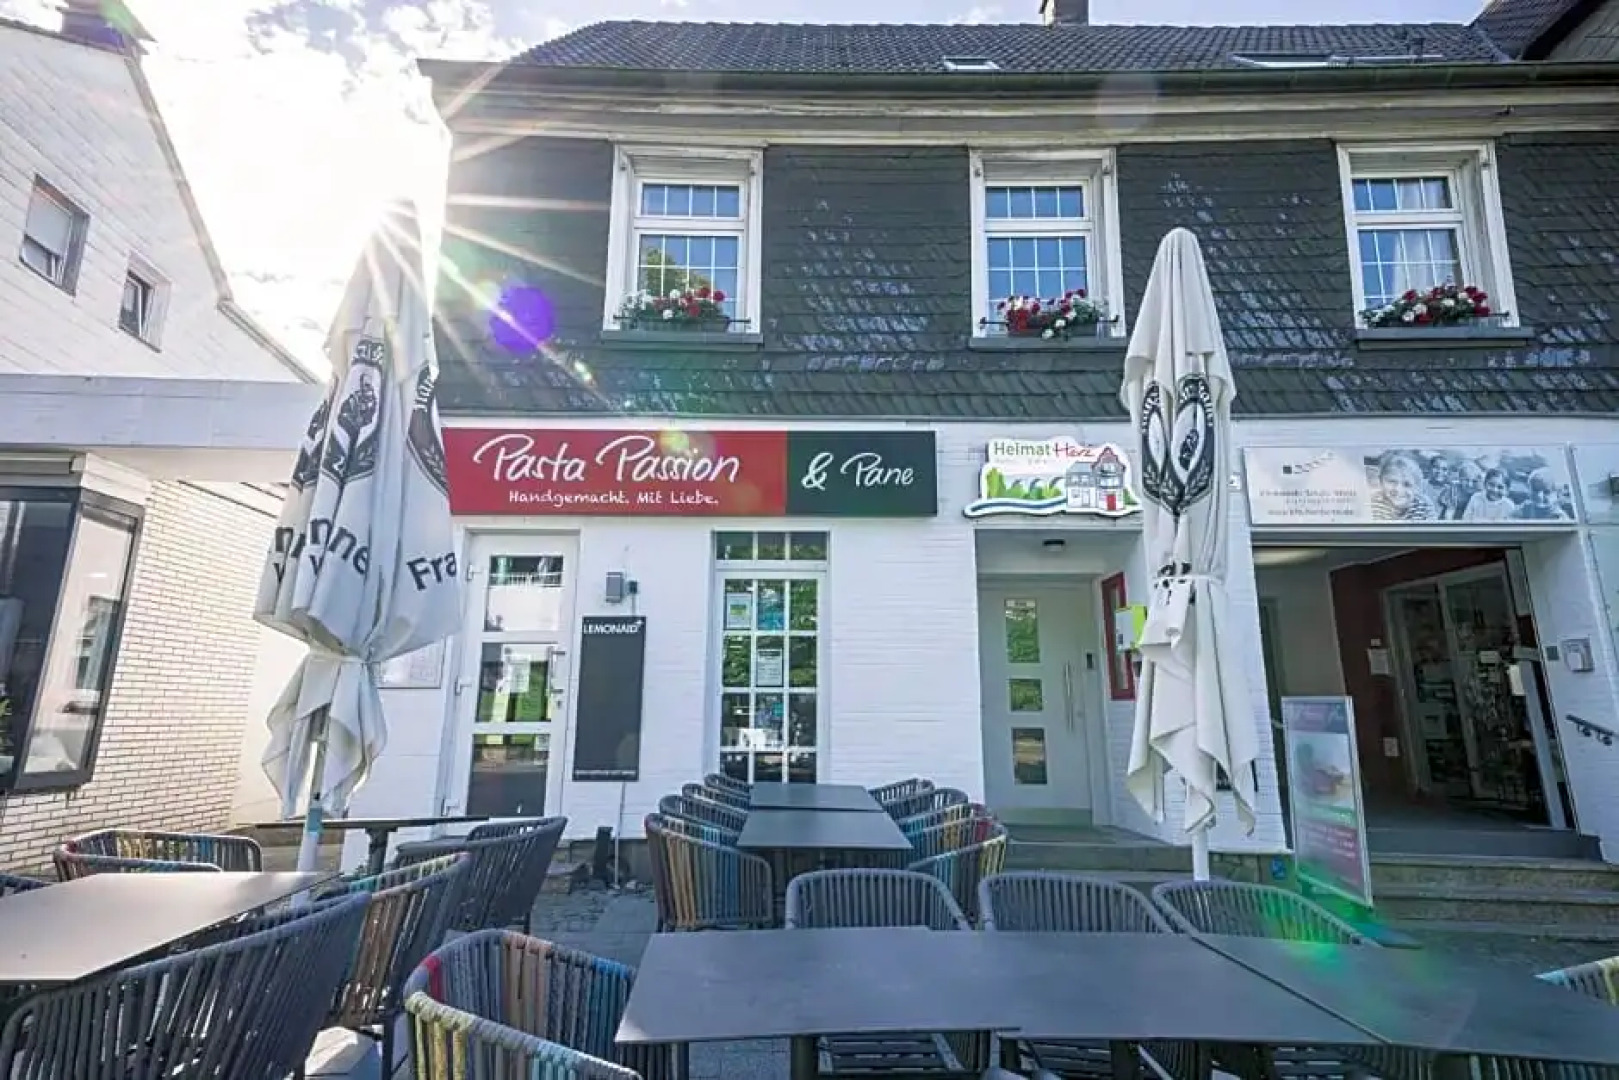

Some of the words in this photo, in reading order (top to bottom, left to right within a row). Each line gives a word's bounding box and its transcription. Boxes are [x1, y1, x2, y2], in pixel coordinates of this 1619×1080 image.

[473, 433, 585, 482] Pasta
[595, 434, 740, 483] Passion
[994, 442, 1050, 456] Heimat
[801, 452, 834, 491] &
[840, 452, 914, 487] Pane
[509, 489, 630, 508] Handgemacht.
[638, 491, 662, 504] Mit
[670, 491, 719, 504] Liebe.
